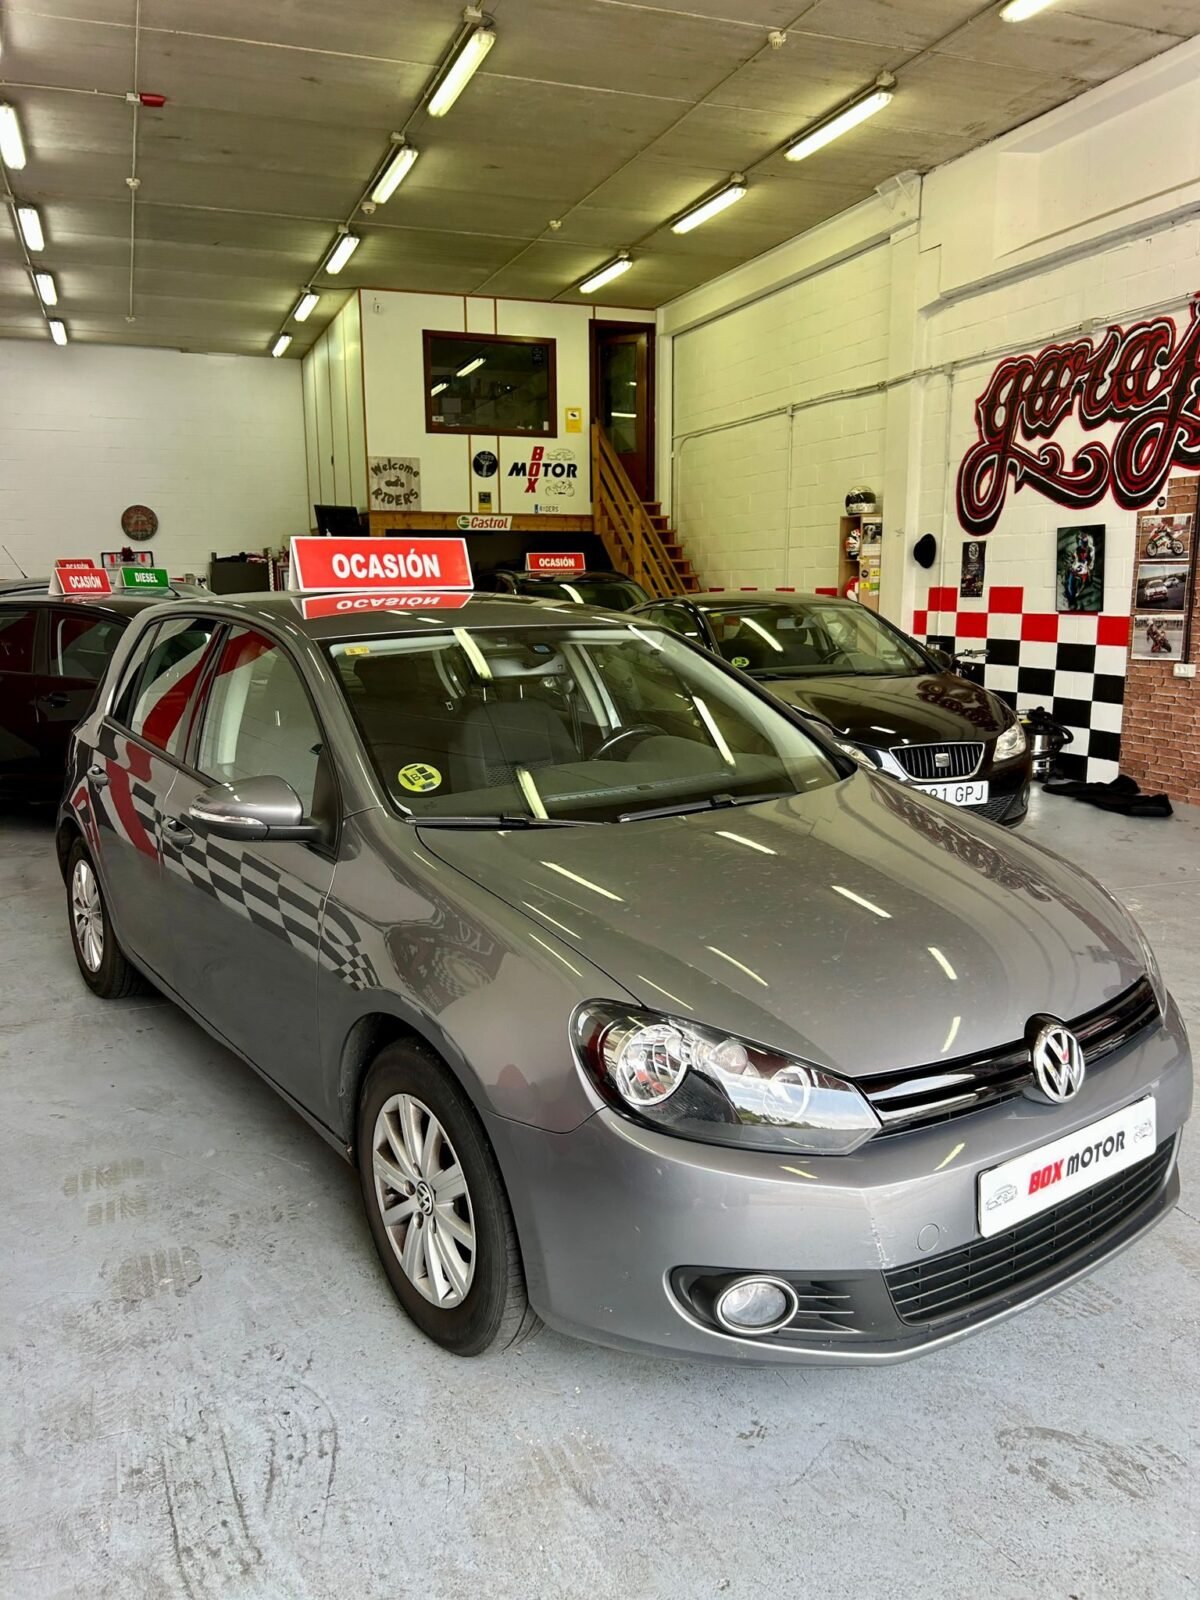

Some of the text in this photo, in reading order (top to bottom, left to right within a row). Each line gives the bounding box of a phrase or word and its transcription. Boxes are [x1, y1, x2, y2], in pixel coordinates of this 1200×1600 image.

[371, 458, 420, 478] Welcome
[372, 487, 419, 506] RIDERS
[470, 516, 509, 529] Castrol
[331, 548, 441, 579] OCASIÓN
[538, 556, 576, 567] OCASIÓN
[69, 573, 103, 589] OCASIÓN
[134, 572, 158, 583] DIESEL
[955, 784, 984, 802] GPJ
[1028, 1130, 1126, 1195] BOX MOTOR
